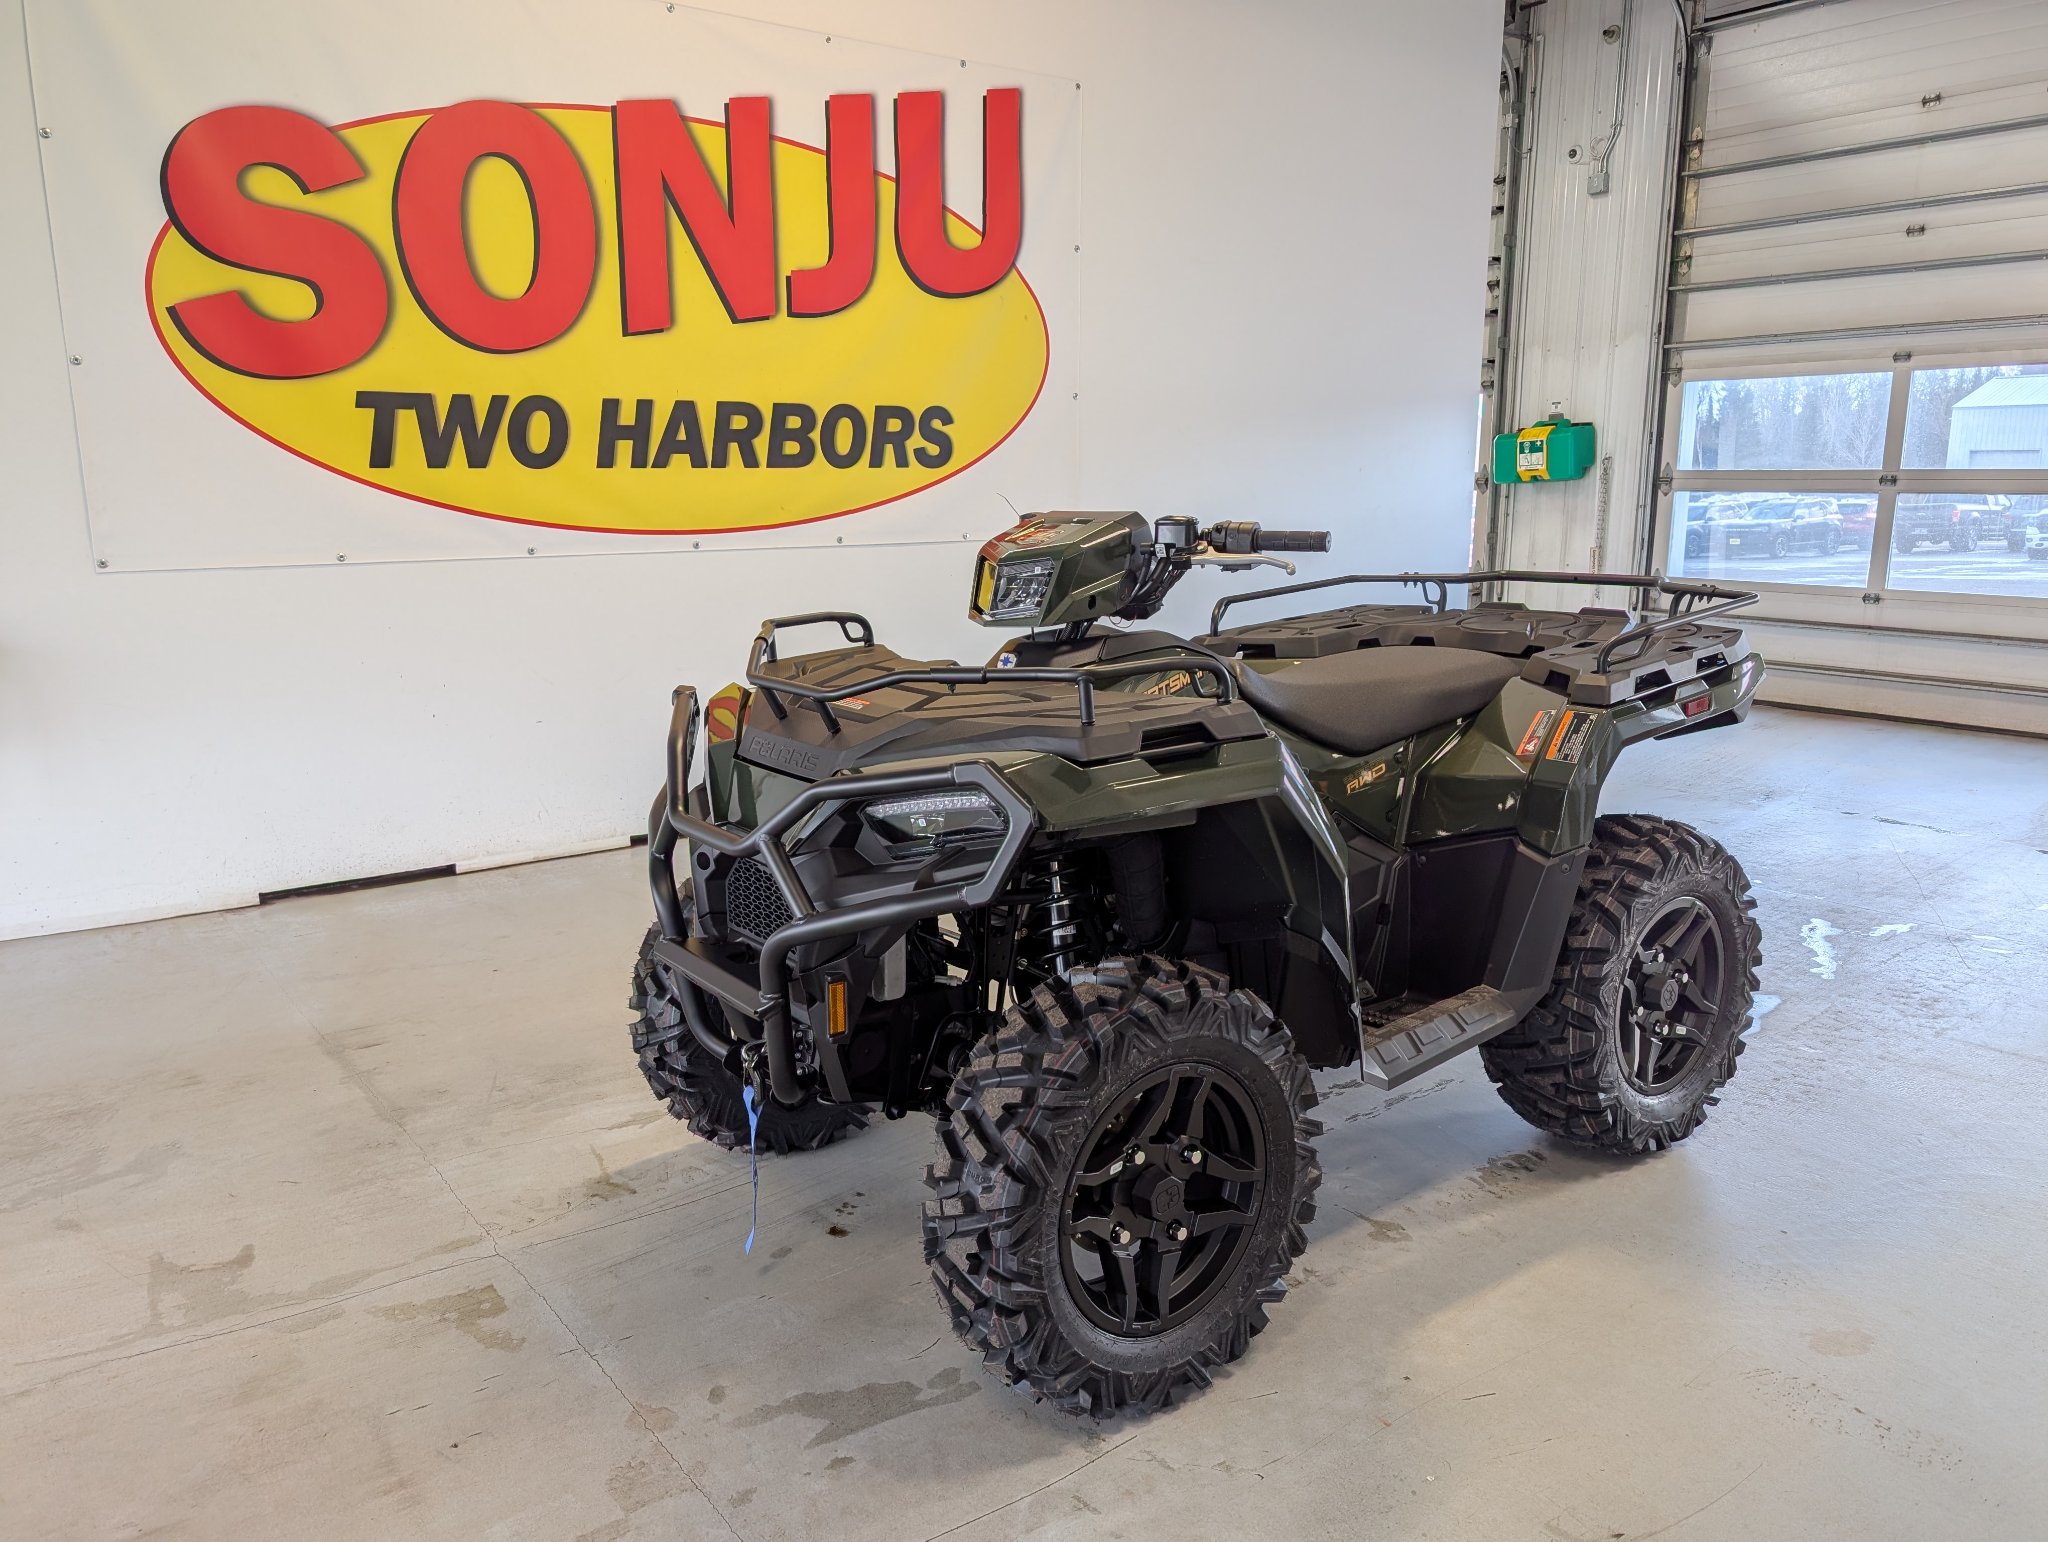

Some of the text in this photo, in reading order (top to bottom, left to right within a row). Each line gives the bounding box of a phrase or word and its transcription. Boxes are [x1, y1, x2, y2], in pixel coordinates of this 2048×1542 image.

[160, 88, 1020, 379] SONJU
[355, 391, 953, 469] TWO HARBORS
[748, 735, 820, 771] POLARIS
[1346, 763, 1386, 795] AWD
